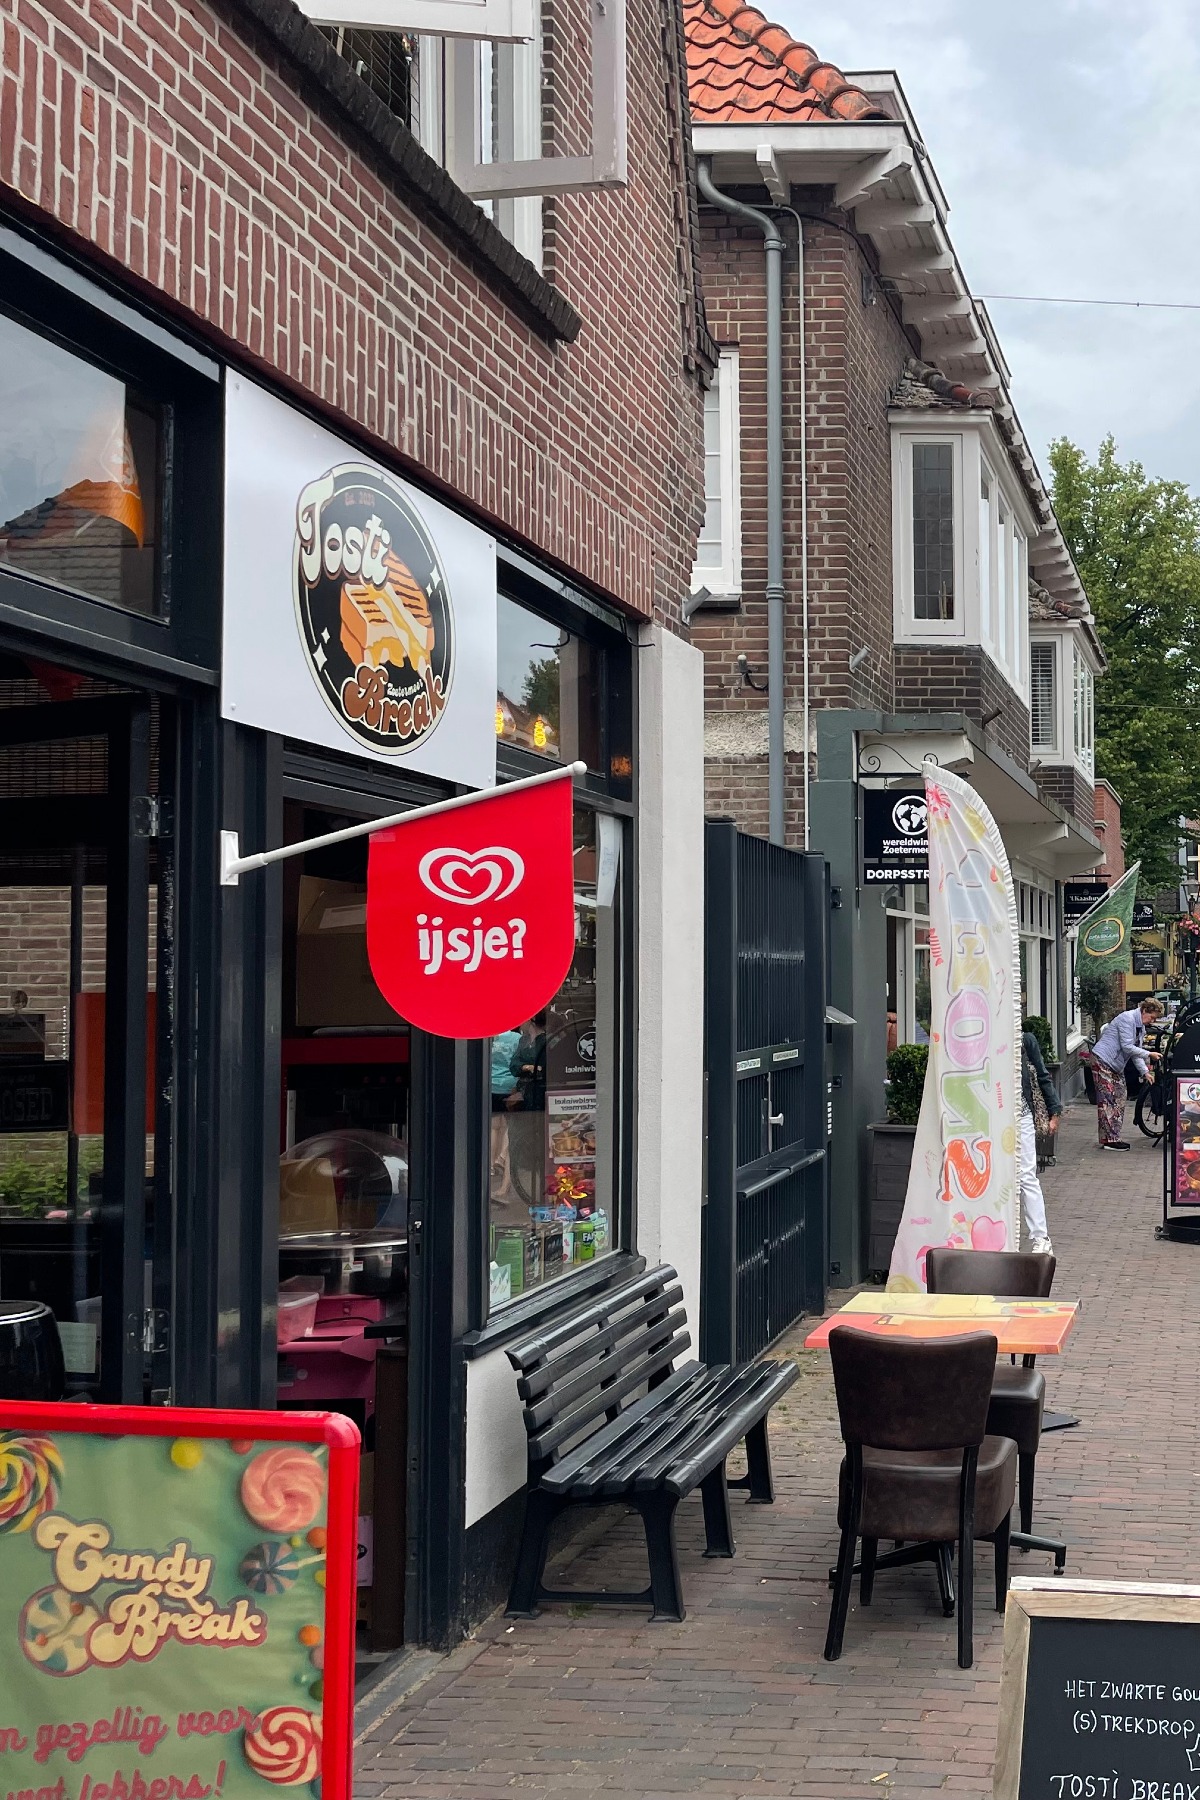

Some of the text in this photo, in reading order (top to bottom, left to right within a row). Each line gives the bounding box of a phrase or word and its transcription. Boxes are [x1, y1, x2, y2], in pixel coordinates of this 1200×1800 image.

[298, 470, 390, 588] Tosti
[341, 664, 446, 739] Break
[416, 914, 527, 975] ijsje?
[35, 1515, 212, 1617] Candy
[90, 1583, 263, 1663] Break
[1064, 1680, 1097, 1699] HET
[1100, 1681, 1166, 1701] ZWARTE
[33, 1705, 168, 1764] gezellig
[177, 1705, 260, 1738] voor
[1132, 1779, 1200, 1800] BREAK
